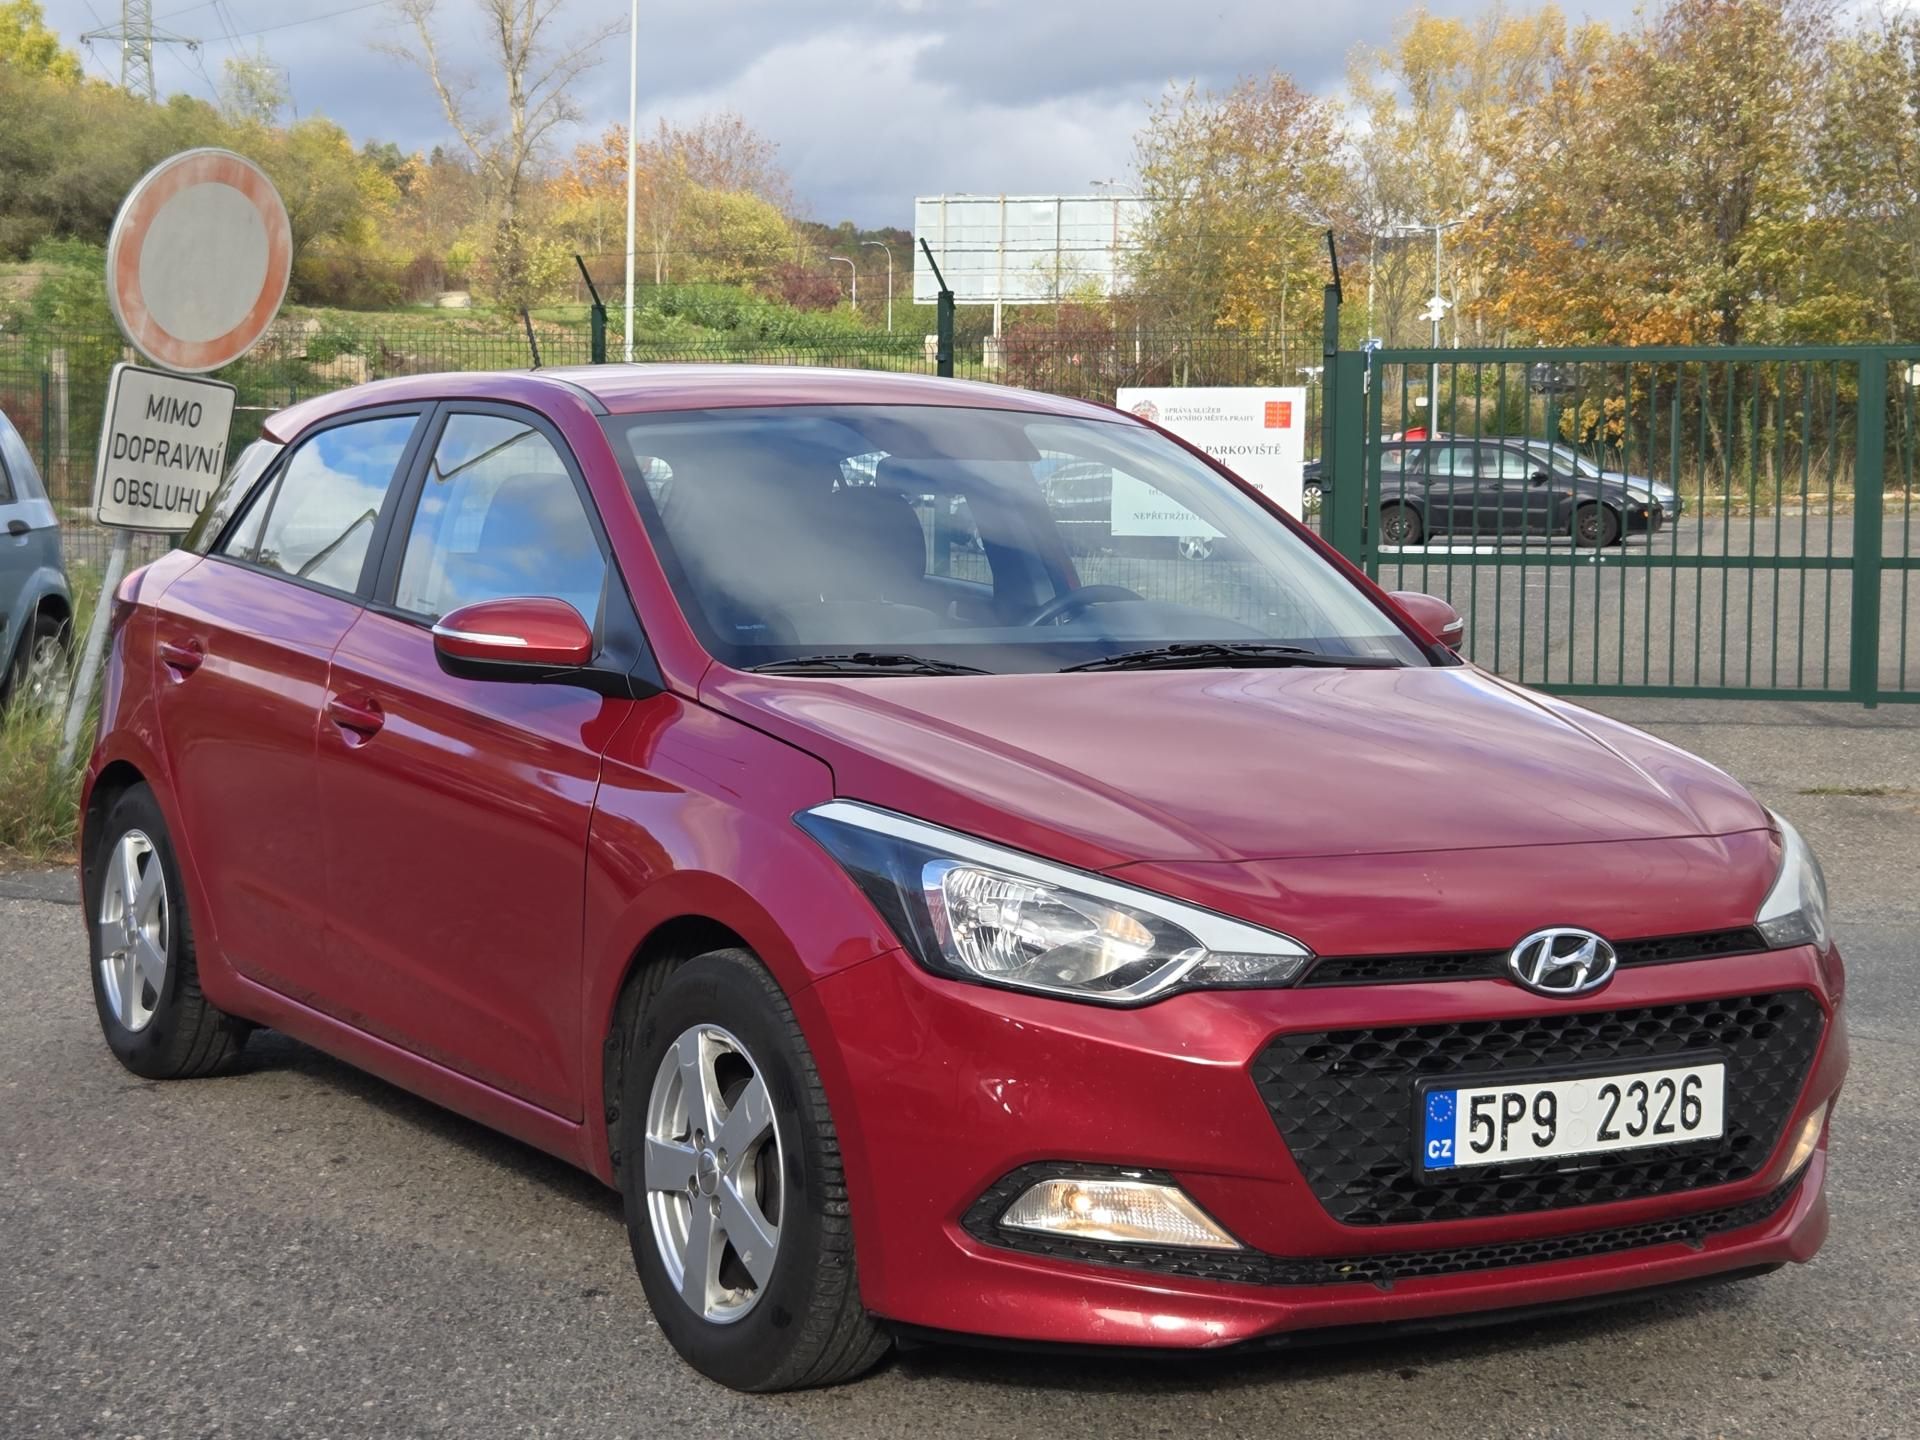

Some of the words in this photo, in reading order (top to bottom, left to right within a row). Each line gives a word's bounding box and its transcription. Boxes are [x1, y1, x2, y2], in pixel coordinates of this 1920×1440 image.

[146, 394, 203, 428] MIMO
[1164, 406, 1192, 414] SPRÁVA
[1164, 414, 1203, 422] HLAVNÍHO
[1204, 414, 1228, 422] MĚSTA
[113, 432, 223, 475] DOPRAVNÍ
[1205, 443, 1281, 455] PARKOVIŠTĚ
[113, 477, 210, 516] OBSLUHU
[1469, 1090, 1558, 1154] 5P9
[1596, 1073, 1702, 1142] 2326
[1428, 1139, 1451, 1158] CZ
